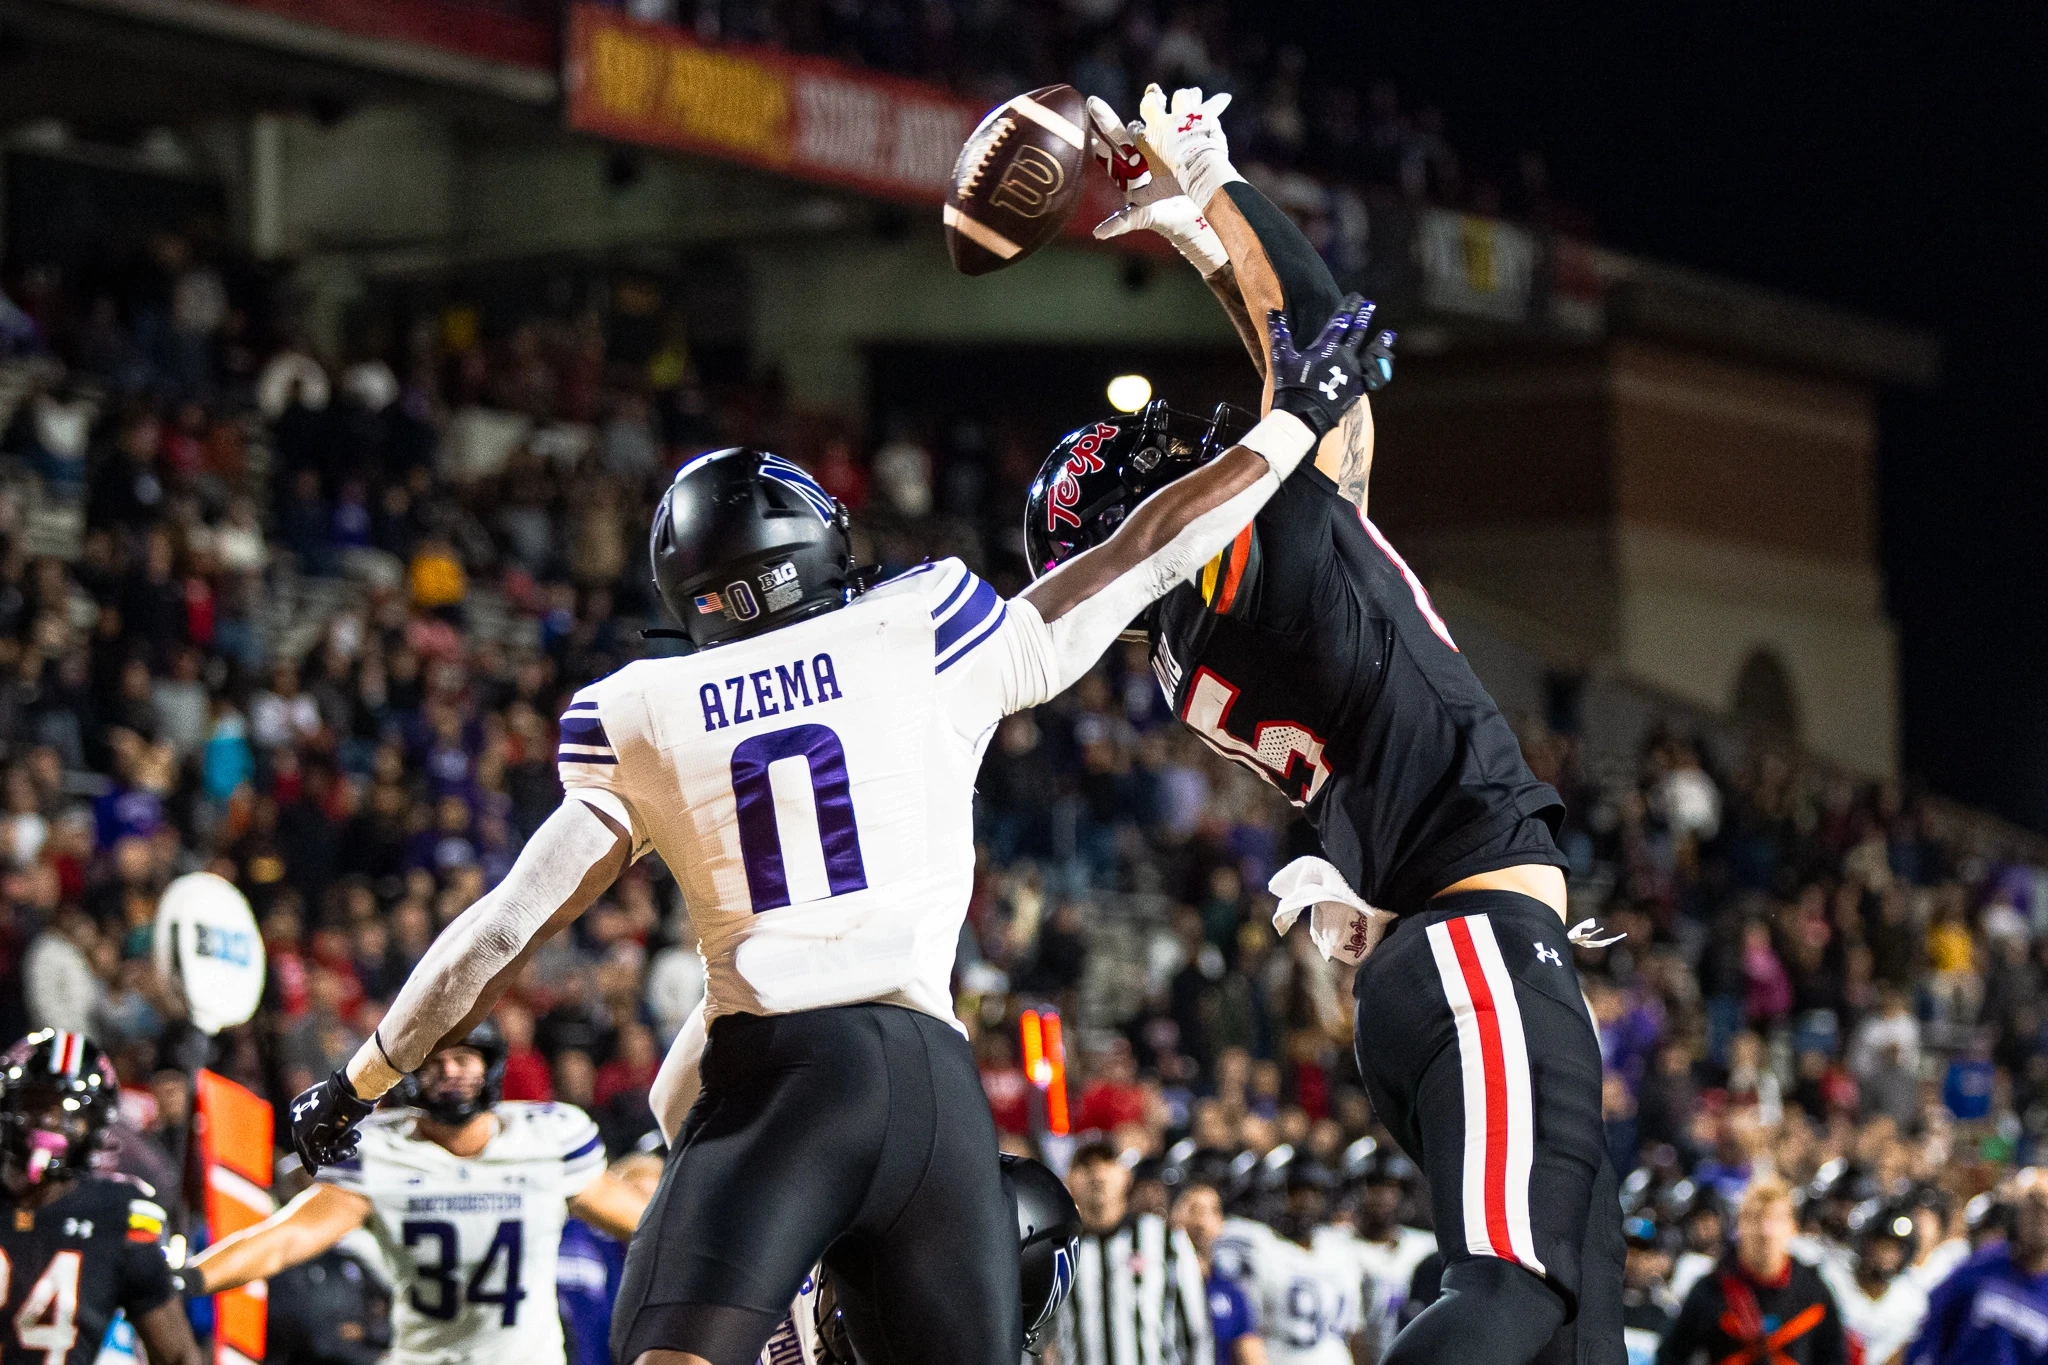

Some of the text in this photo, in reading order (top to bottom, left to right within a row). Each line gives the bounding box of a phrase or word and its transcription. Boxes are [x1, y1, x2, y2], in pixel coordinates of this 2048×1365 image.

[1047, 422, 1120, 532] Terps
[700, 652, 843, 733] AZEMA
[730, 723, 869, 914] 0
[0, 1246, 84, 1365] 4
[403, 1219, 528, 1328] 34
